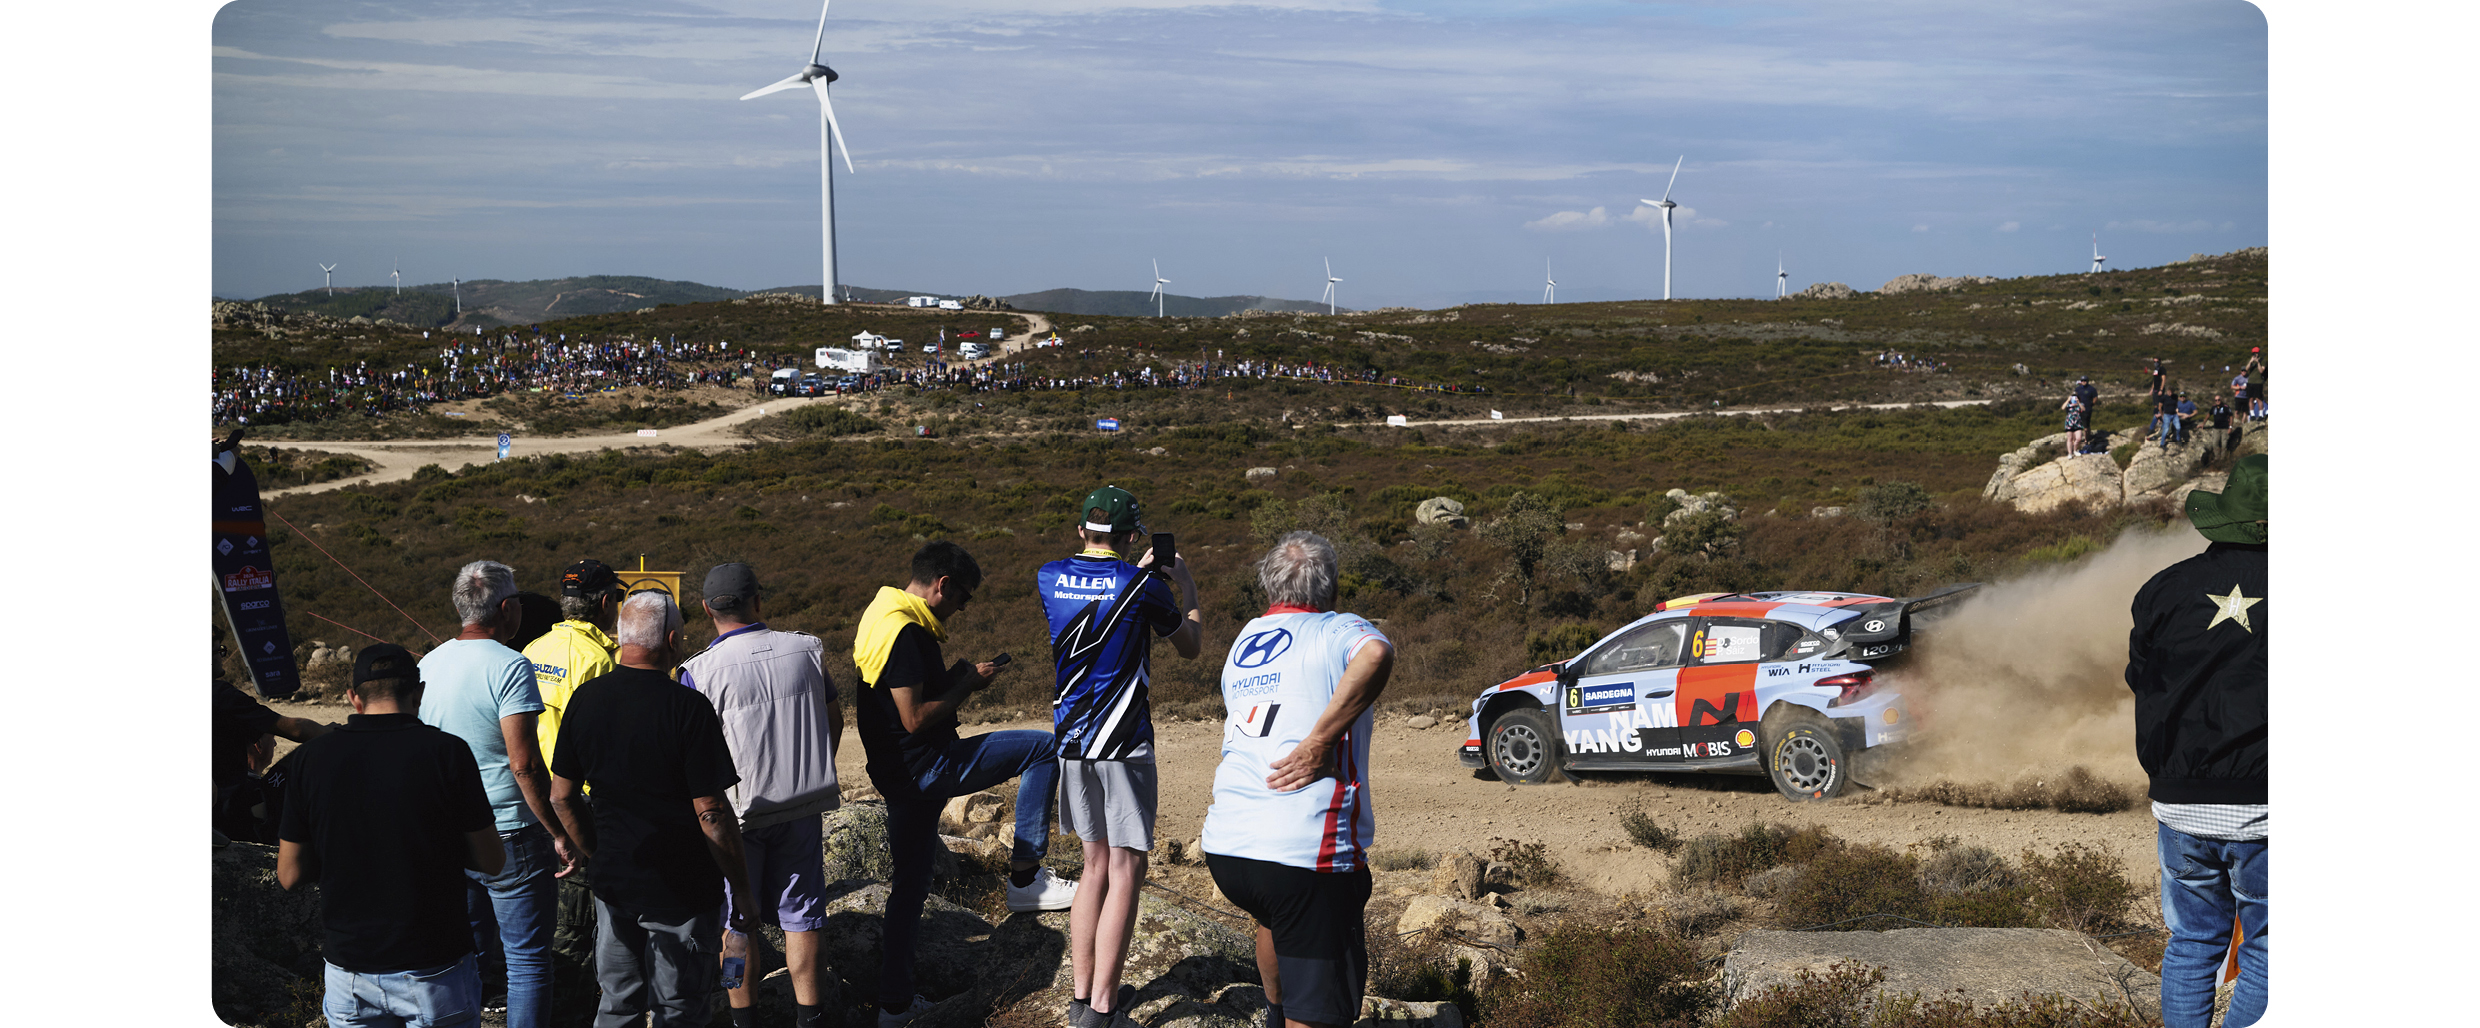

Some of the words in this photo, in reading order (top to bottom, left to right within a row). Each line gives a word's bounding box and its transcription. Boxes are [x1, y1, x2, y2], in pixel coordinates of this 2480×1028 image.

[227, 578, 248, 588] RALLY
[249, 575, 269, 585] ITALIA
[1055, 574, 1116, 589] ALLEN
[1054, 591, 1115, 602] Motorsport
[240, 600, 270, 610] sparco
[1692, 630, 1704, 658] 6
[1730, 635, 1759, 646] Sordo
[532, 663, 567, 678] SUZUKI
[1232, 672, 1281, 690] HYUNDAI
[1569, 688, 1578, 707] 6
[1585, 688, 1633, 701] SARDEGNA
[1608, 702, 1679, 730] NAM
[1563, 728, 1642, 754] YANG
[1646, 747, 1681, 756] HYUNDAI
[1682, 740, 1731, 758] MOBIS
